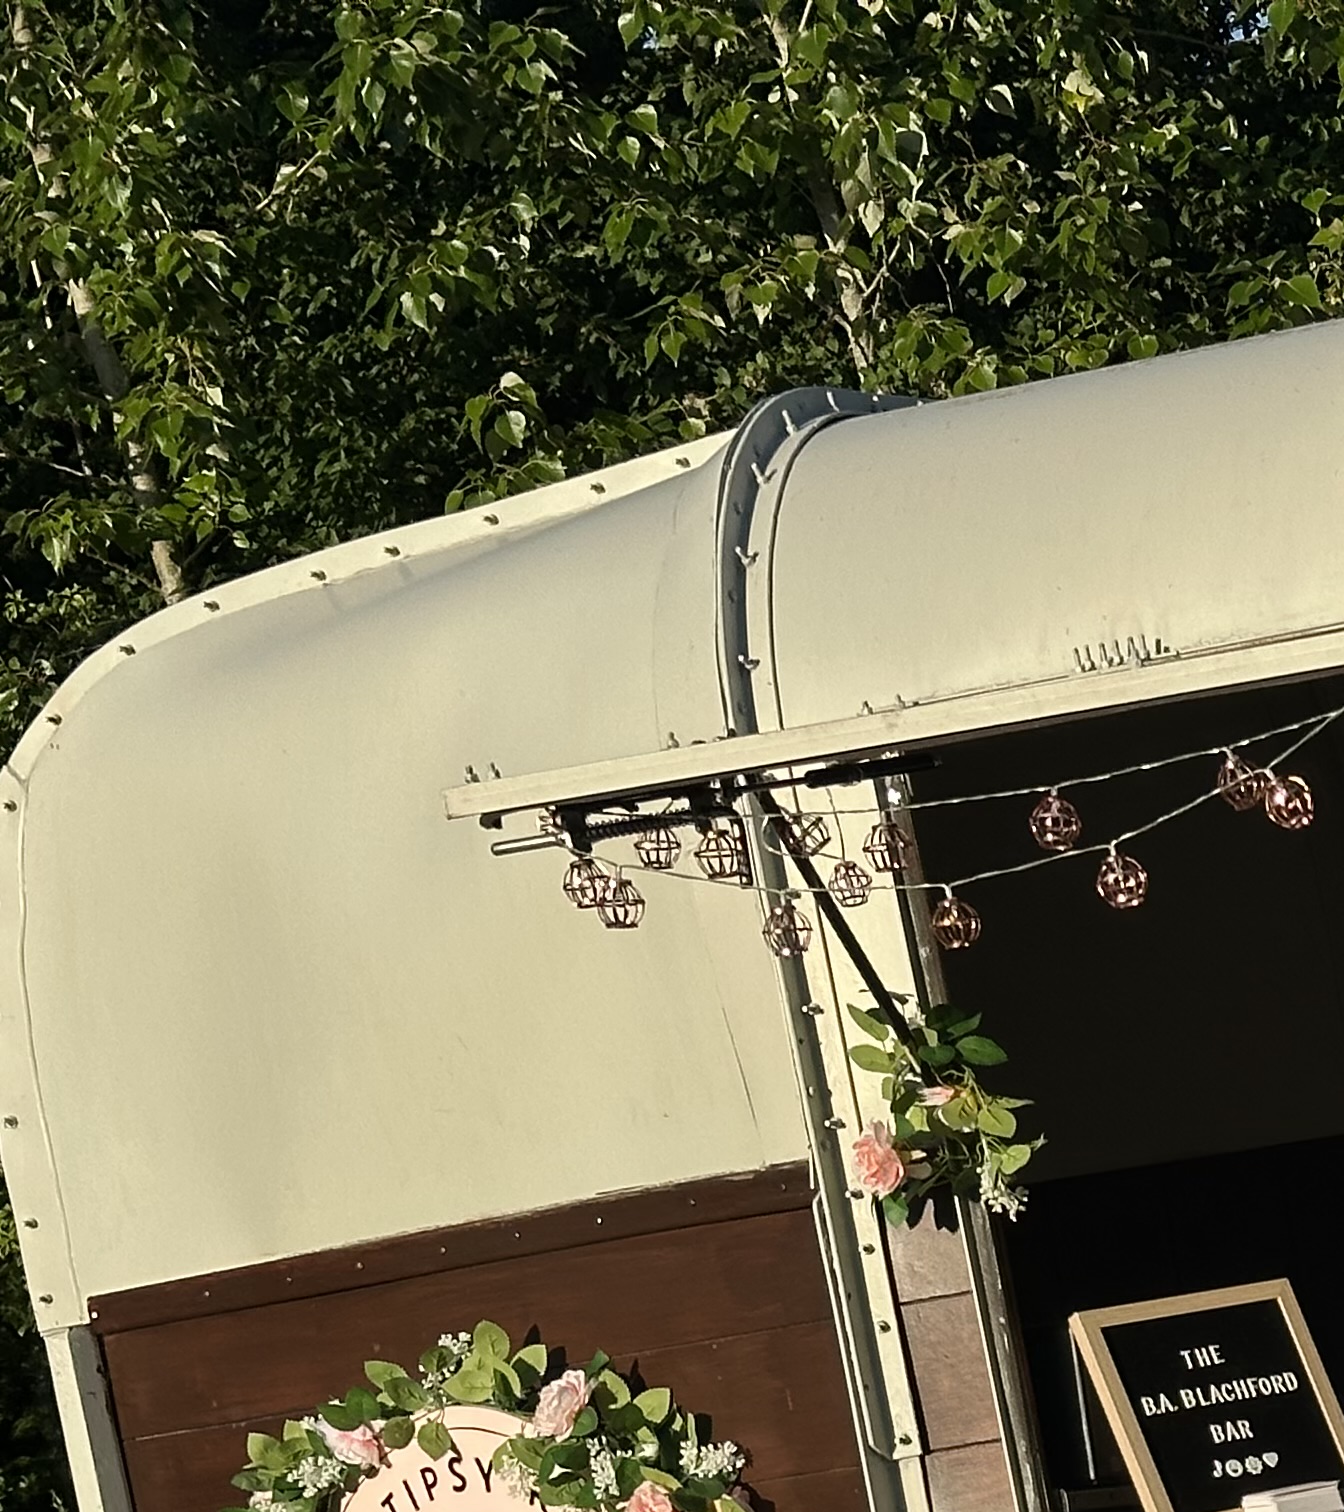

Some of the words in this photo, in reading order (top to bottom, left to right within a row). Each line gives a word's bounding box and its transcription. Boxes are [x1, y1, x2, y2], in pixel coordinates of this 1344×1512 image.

[1179, 1344, 1226, 1370] THE
[1140, 1392, 1179, 1417] B.A.
[1180, 1371, 1299, 1409] BLACHFORD
[1209, 1419, 1254, 1445] BAR
